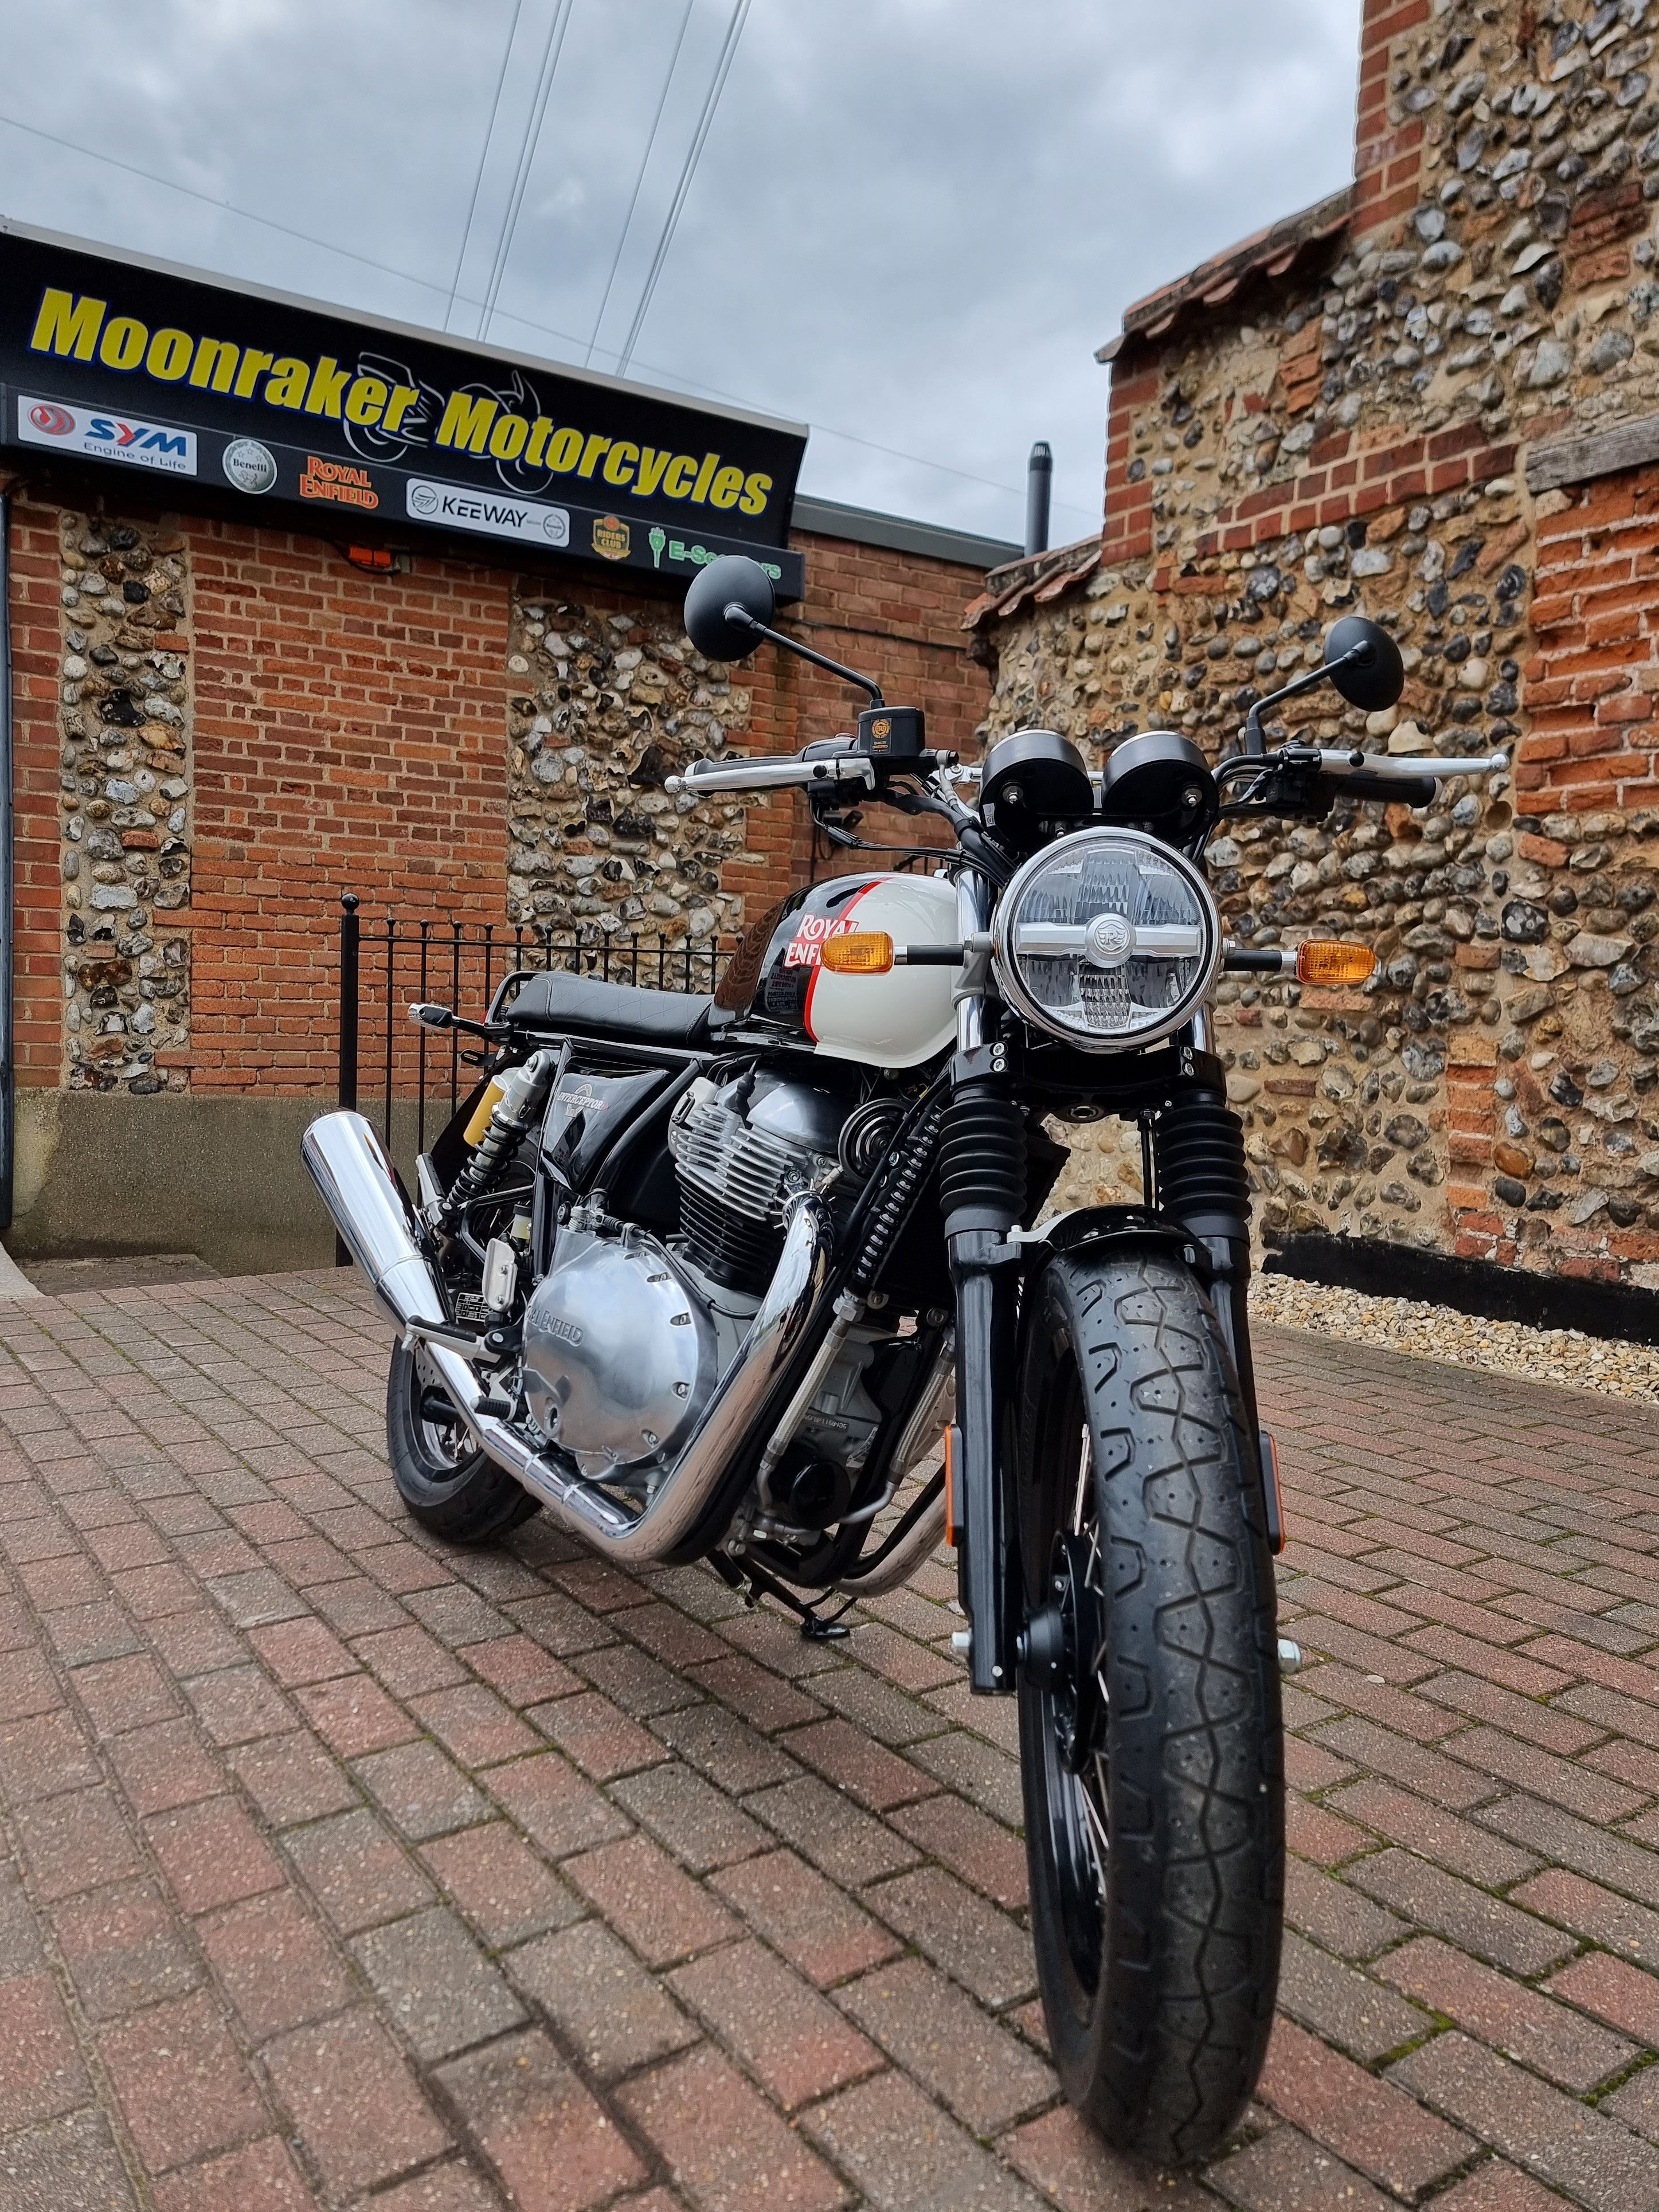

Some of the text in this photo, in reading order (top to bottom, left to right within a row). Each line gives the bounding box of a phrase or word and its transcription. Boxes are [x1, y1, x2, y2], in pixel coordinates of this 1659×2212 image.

[30, 287, 773, 515] Moonraker Motorcycles
[85, 418, 187, 457] SYM
[83, 441, 186, 471] Engine of Life
[232, 457, 267, 473] Benelli
[307, 456, 371, 488] ROYAL
[300, 474, 379, 509] ENFIELD
[442, 495, 528, 528] KEEWAY
[597, 529, 626, 542] RIDERS
[600, 538, 621, 549] CLUB
[557, 1092, 604, 1111] INTERCEPTOR
